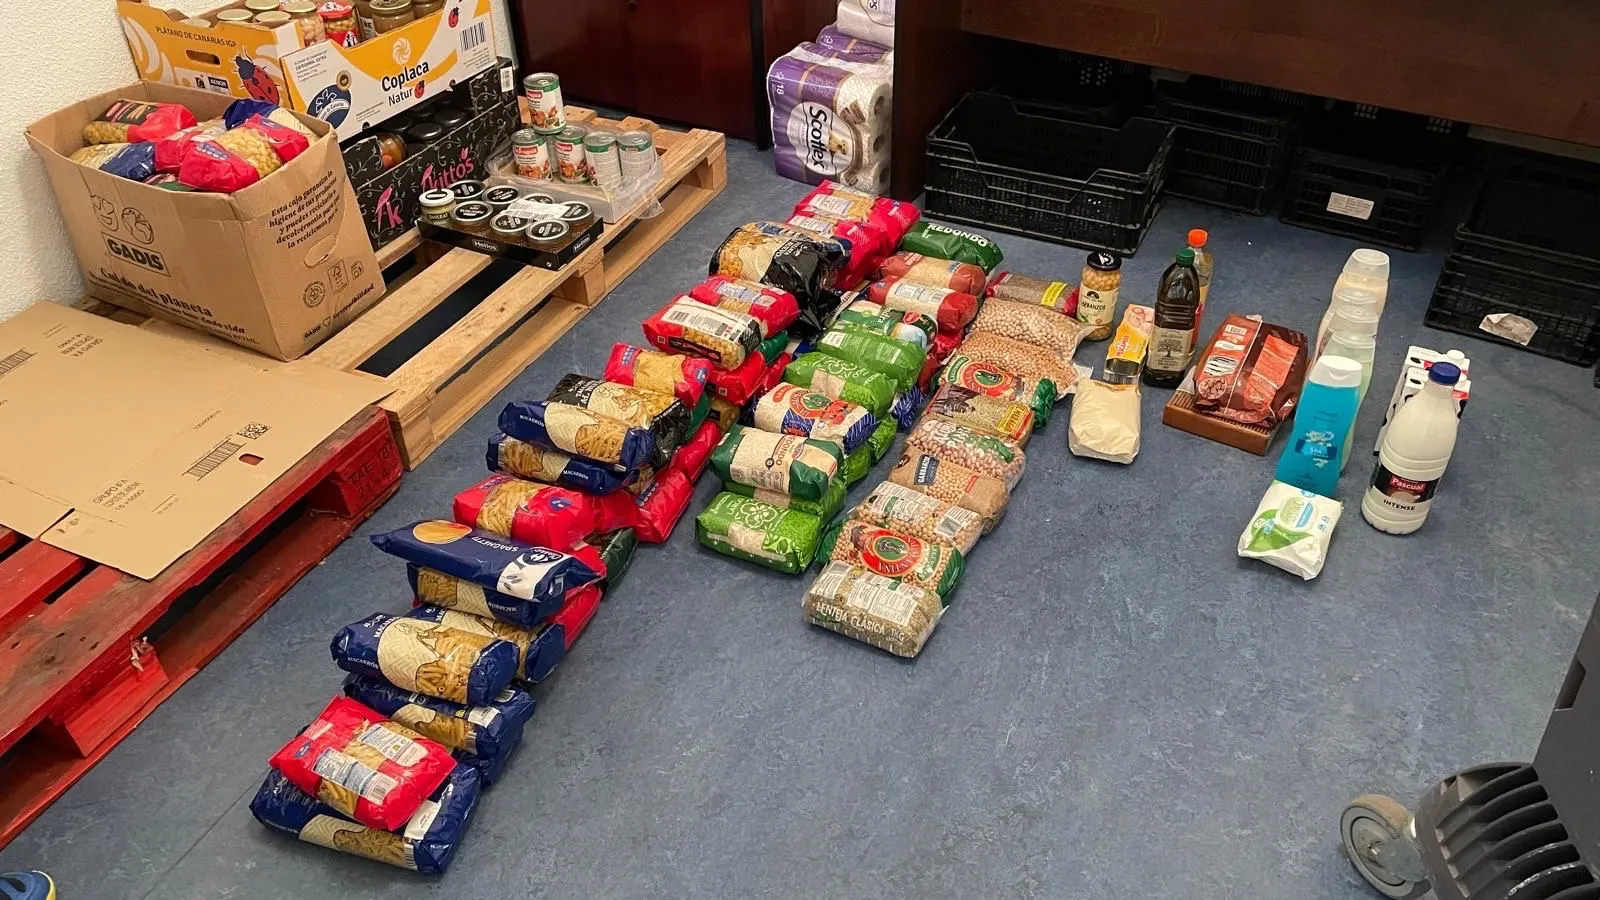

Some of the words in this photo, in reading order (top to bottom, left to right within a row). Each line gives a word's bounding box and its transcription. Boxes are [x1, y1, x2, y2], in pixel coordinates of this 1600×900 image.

[194, 33, 225, 46] CANARIAS
[381, 60, 430, 92] Coplaca
[388, 86, 413, 107] Natur
[776, 84, 785, 95] 18
[809, 105, 827, 170] Scottex
[269, 209, 297, 228] higiene
[297, 203, 305, 213] de
[305, 197, 315, 207] tus
[271, 204, 288, 217] Esta
[288, 195, 303, 208] caja
[286, 213, 309, 232] puedes
[287, 241, 296, 249] la
[926, 222, 988, 247] REDONDO
[106, 238, 164, 272] GADIS
[474, 240, 497, 251] Helios
[137, 284, 158, 298] del
[159, 293, 213, 318] planeta
[775, 435, 793, 467] EDONDO
[1391, 477, 1424, 491] Pascual
[1383, 498, 1416, 511] INTENSE
[471, 536, 519, 552] SPAGHETTI
[816, 601, 848, 622] LENTEJA
[851, 615, 885, 635] CLÁSICA
